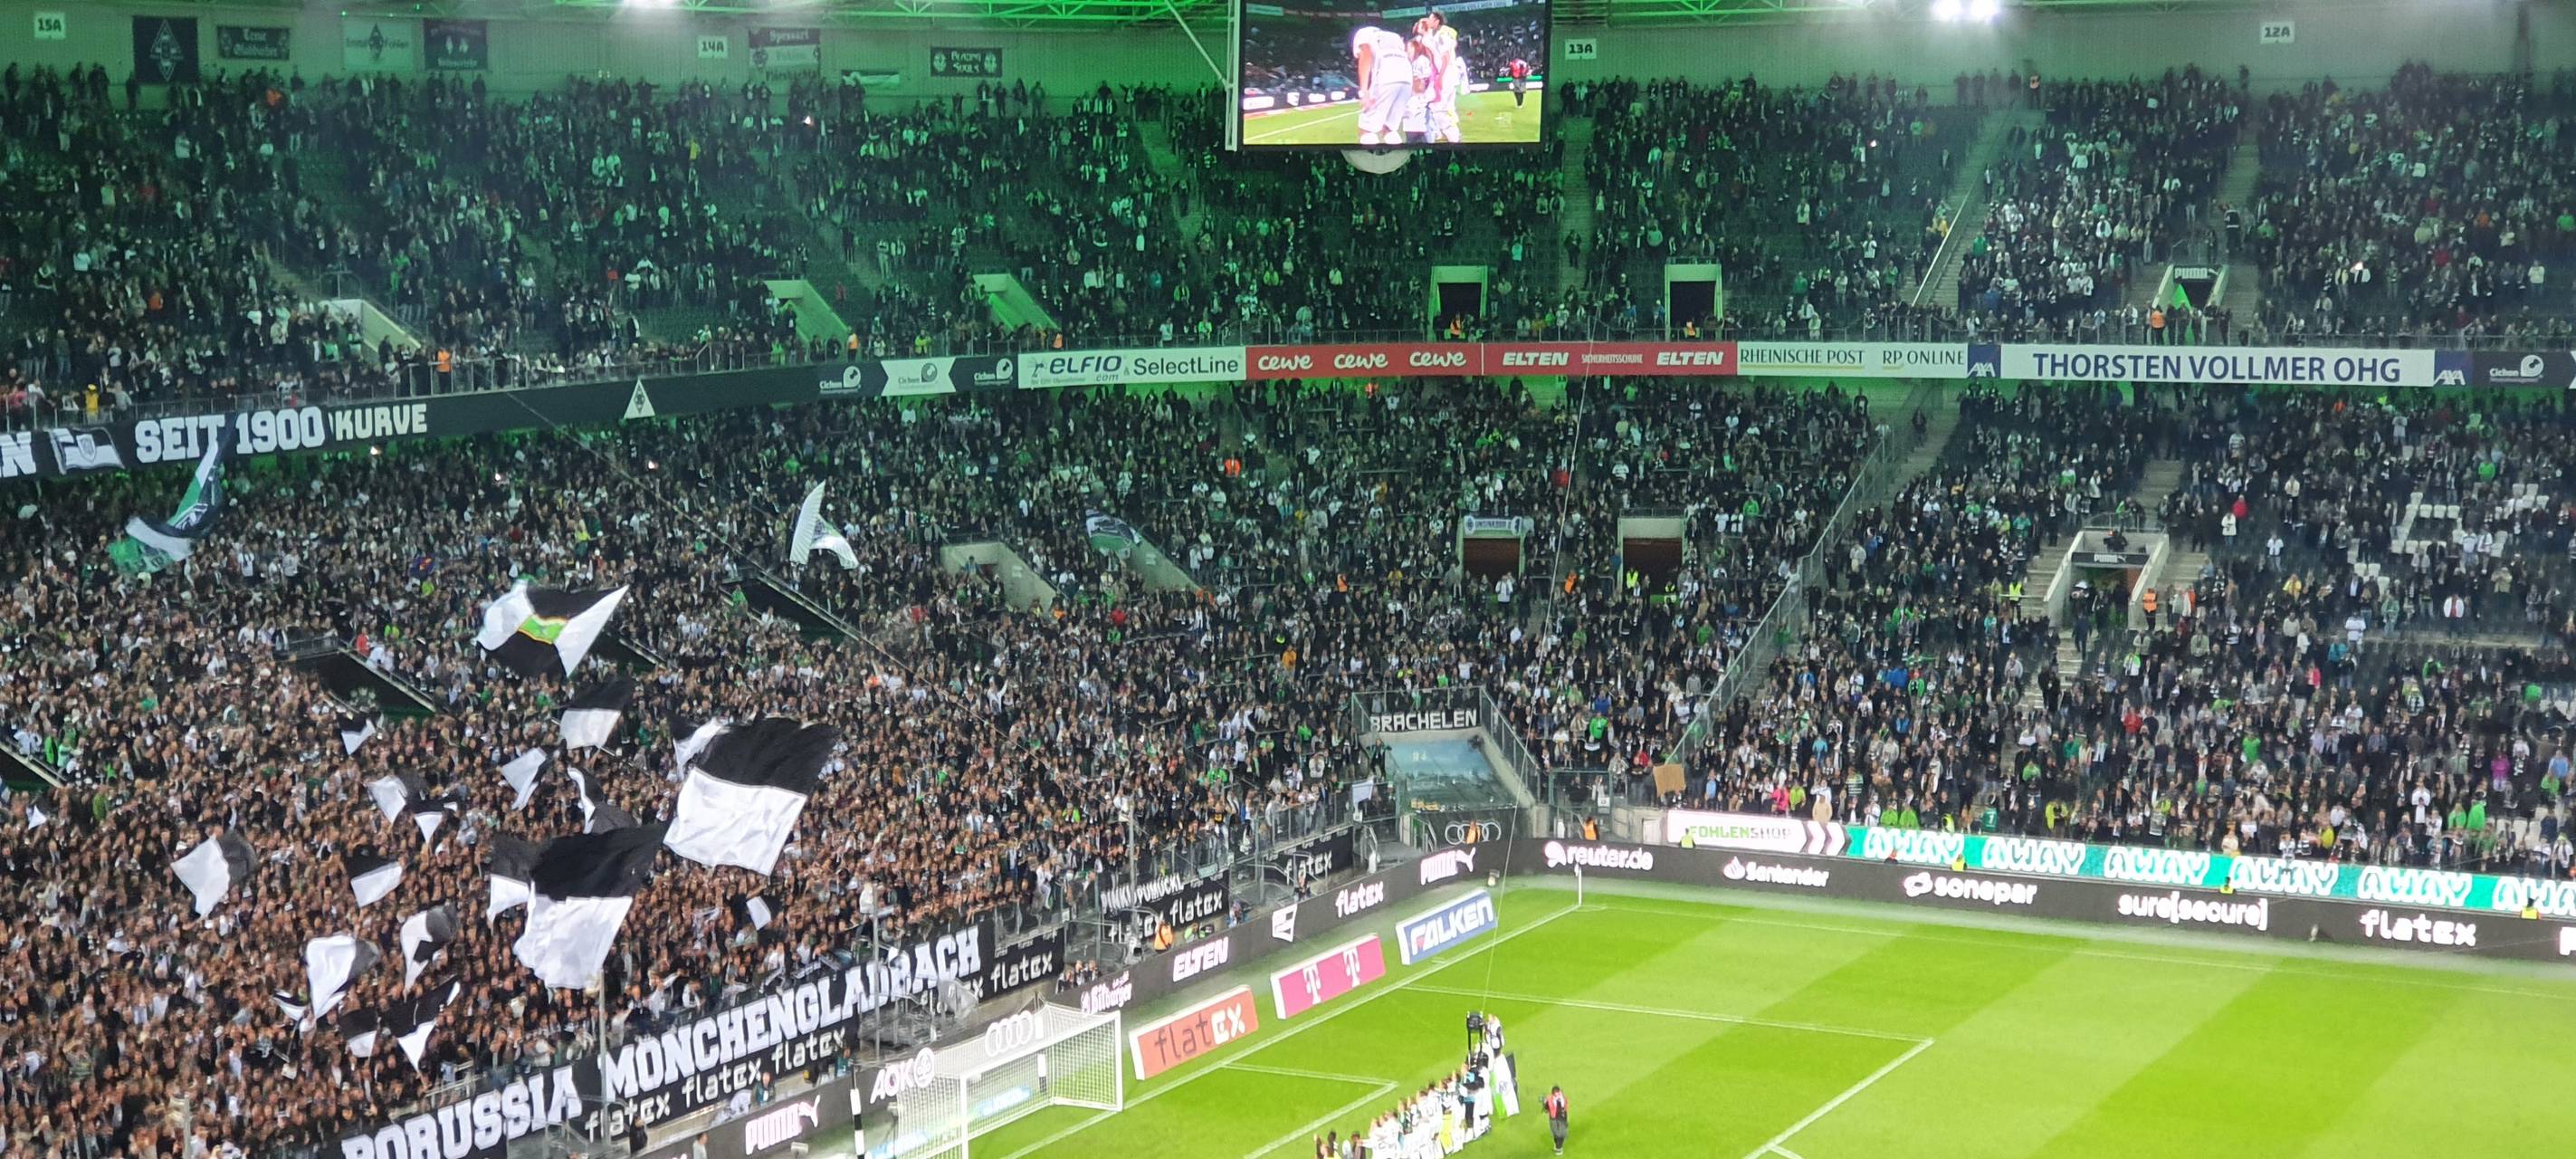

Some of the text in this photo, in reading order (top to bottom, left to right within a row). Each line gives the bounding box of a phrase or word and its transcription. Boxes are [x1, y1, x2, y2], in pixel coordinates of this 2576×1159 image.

[38, 19, 62, 32] 15A
[2265, 26, 2290, 37] 12A
[701, 41, 723, 52] 14A
[1569, 43, 1592, 53] 13A
[1133, 356, 1239, 376] SelectLine
[1258, 355, 1312, 370] cewe
[1333, 353, 1388, 369] cewe
[1409, 351, 1466, 367] cewe
[1503, 351, 1569, 366] ELTEN
[1656, 351, 1723, 366] ELTEN
[1740, 349, 1865, 364] RHEINISCHE POST
[1883, 350, 1964, 365] RP ONLINE
[2033, 352, 2401, 383] THORSTEN VOLLMER OHG
[1968, 362, 1995, 378] AXA
[2433, 369, 2466, 386] AXA
[2489, 368, 2519, 377] Cichon
[135, 415, 225, 464] SEIT
[235, 406, 325, 455] 1900
[329, 404, 428, 441] KURVE
[1369, 709, 1477, 733] BRACHELEN
[1283, 849, 1332, 885] fatex
[1420, 851, 1459, 886] PUMA
[1567, 844, 1654, 871] reuter.de
[1745, 861, 1830, 887] Santander
[1335, 881, 1384, 919] flatex
[1933, 876, 2037, 905] sonepar
[1169, 889, 1223, 927] flatex
[1410, 896, 1494, 956] FALKEN
[2359, 909, 2477, 947] flatex
[1173, 936, 1229, 982] ELTEN
[1302, 947, 1360, 1005] T T
[682, 1058, 762, 1108] flatex
[771, 1026, 845, 1075] flatex
[990, 951, 1053, 992] flatex
[1154, 1002, 1245, 1067] flatex
[745, 1103, 803, 1156] PUMA
